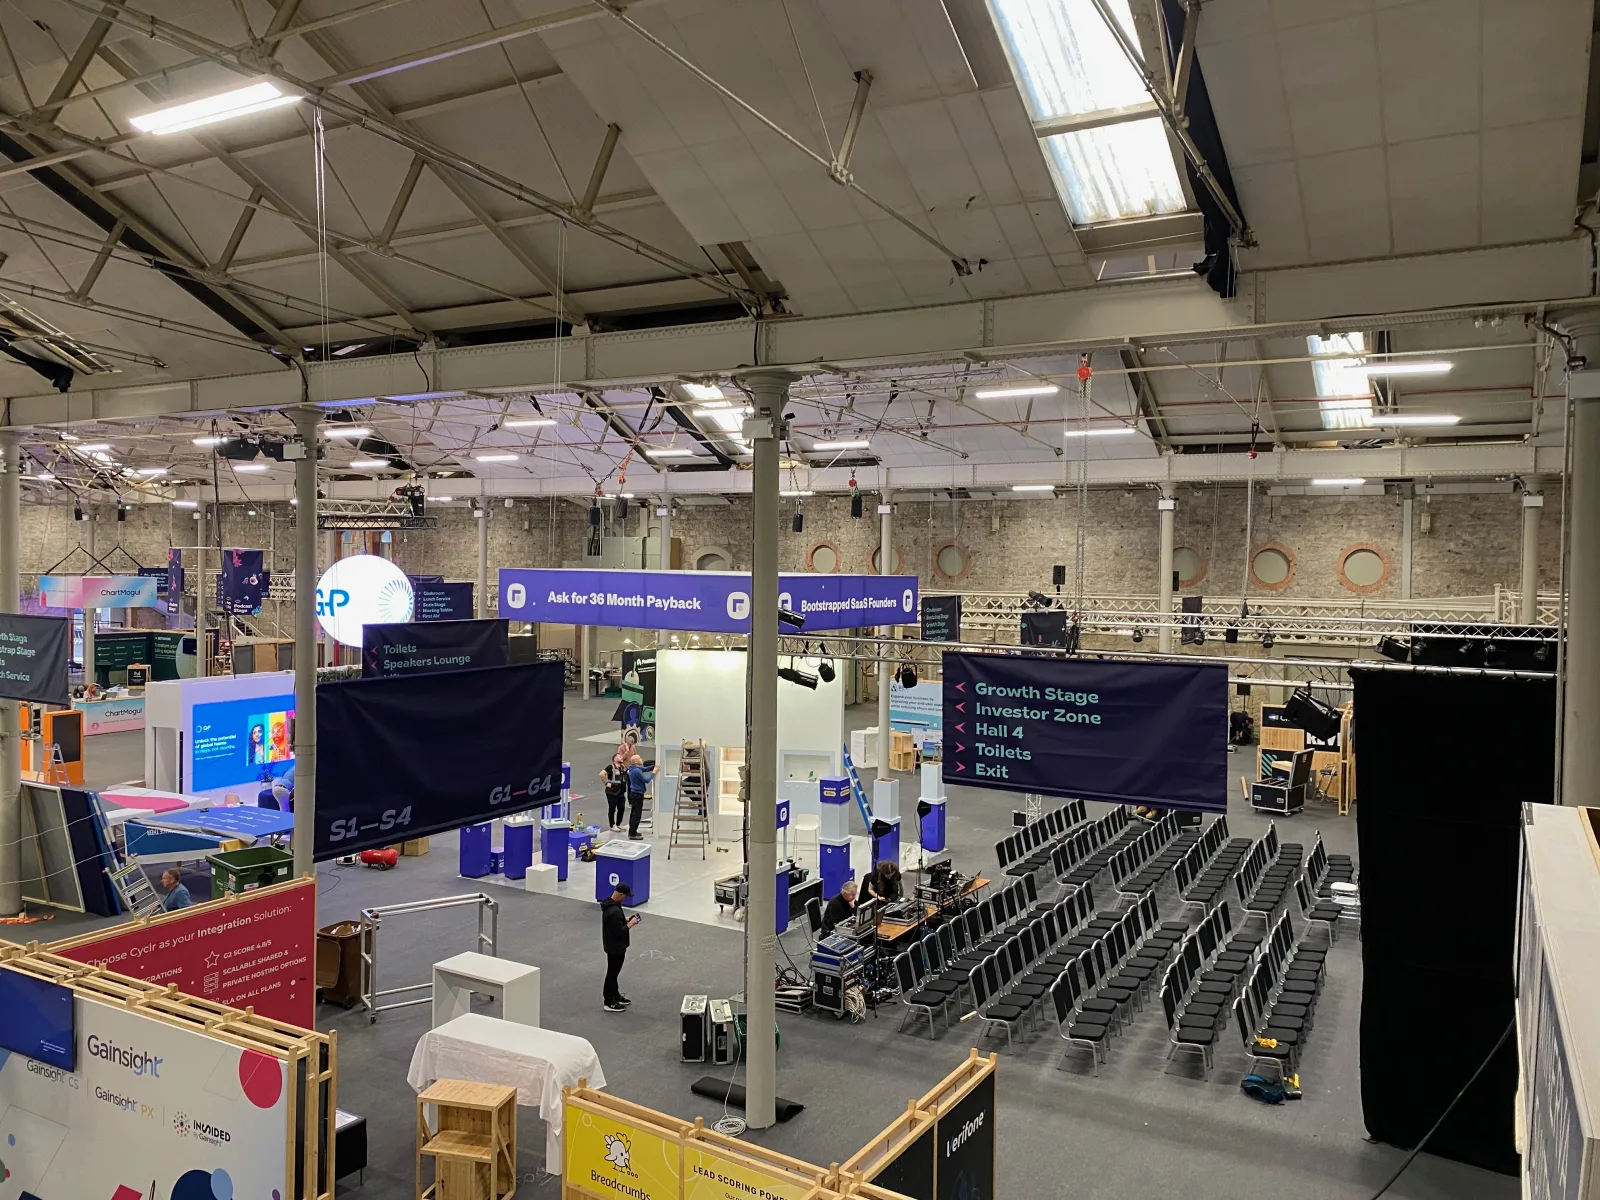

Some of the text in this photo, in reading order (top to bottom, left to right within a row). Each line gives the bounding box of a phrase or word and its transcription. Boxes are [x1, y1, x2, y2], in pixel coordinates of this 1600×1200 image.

[101, 589, 140, 597] ChartMogul
[548, 591, 701, 611] Ask for 36 Month Payback
[801, 597, 896, 612] Bootstrapped SaaS Founders
[9, 633, 27, 644] Stage
[17, 646, 35, 658] Stage
[384, 644, 417, 654] Toilets
[384, 655, 470, 670] Speakers Lounge
[6, 671, 29, 681] Service
[975, 682, 1098, 706] Growth Stage
[105, 708, 142, 717] ChartMogul
[975, 702, 1101, 724] Investor Zone
[975, 723, 1024, 739] Hall 4
[975, 743, 1031, 761] Toilets
[975, 763, 1008, 779] Exit
[130, 943, 156, 957] Cyclr
[158, 940, 170, 949] as
[172, 932, 195, 947] your
[197, 917, 251, 938] Integration
[254, 905, 292, 922] Solution:
[233, 945, 255, 957] SCORE
[256, 940, 272, 949] 4.8/5
[223, 960, 256, 975] SCALABLE
[257, 951, 283, 964] SHARED
[223, 956, 307, 988] PRIVATE HOSTING OPTIONS
[222, 996, 235, 1005] SLA
[248, 989, 259, 997] ALL
[261, 981, 281, 992] PLANS
[87, 1034, 163, 1078] Gainsight
[27, 1060, 79, 1090] Gainsight CS
[95, 1086, 154, 1119] Gainsight PX
[194, 1120, 231, 1142] INSIDED
[199, 1133, 223, 1147] Gainsight
[591, 1169, 650, 1200] Breadcrumbs
[693, 1165, 715, 1179] LEAD
[718, 1174, 757, 1195] SCORING
